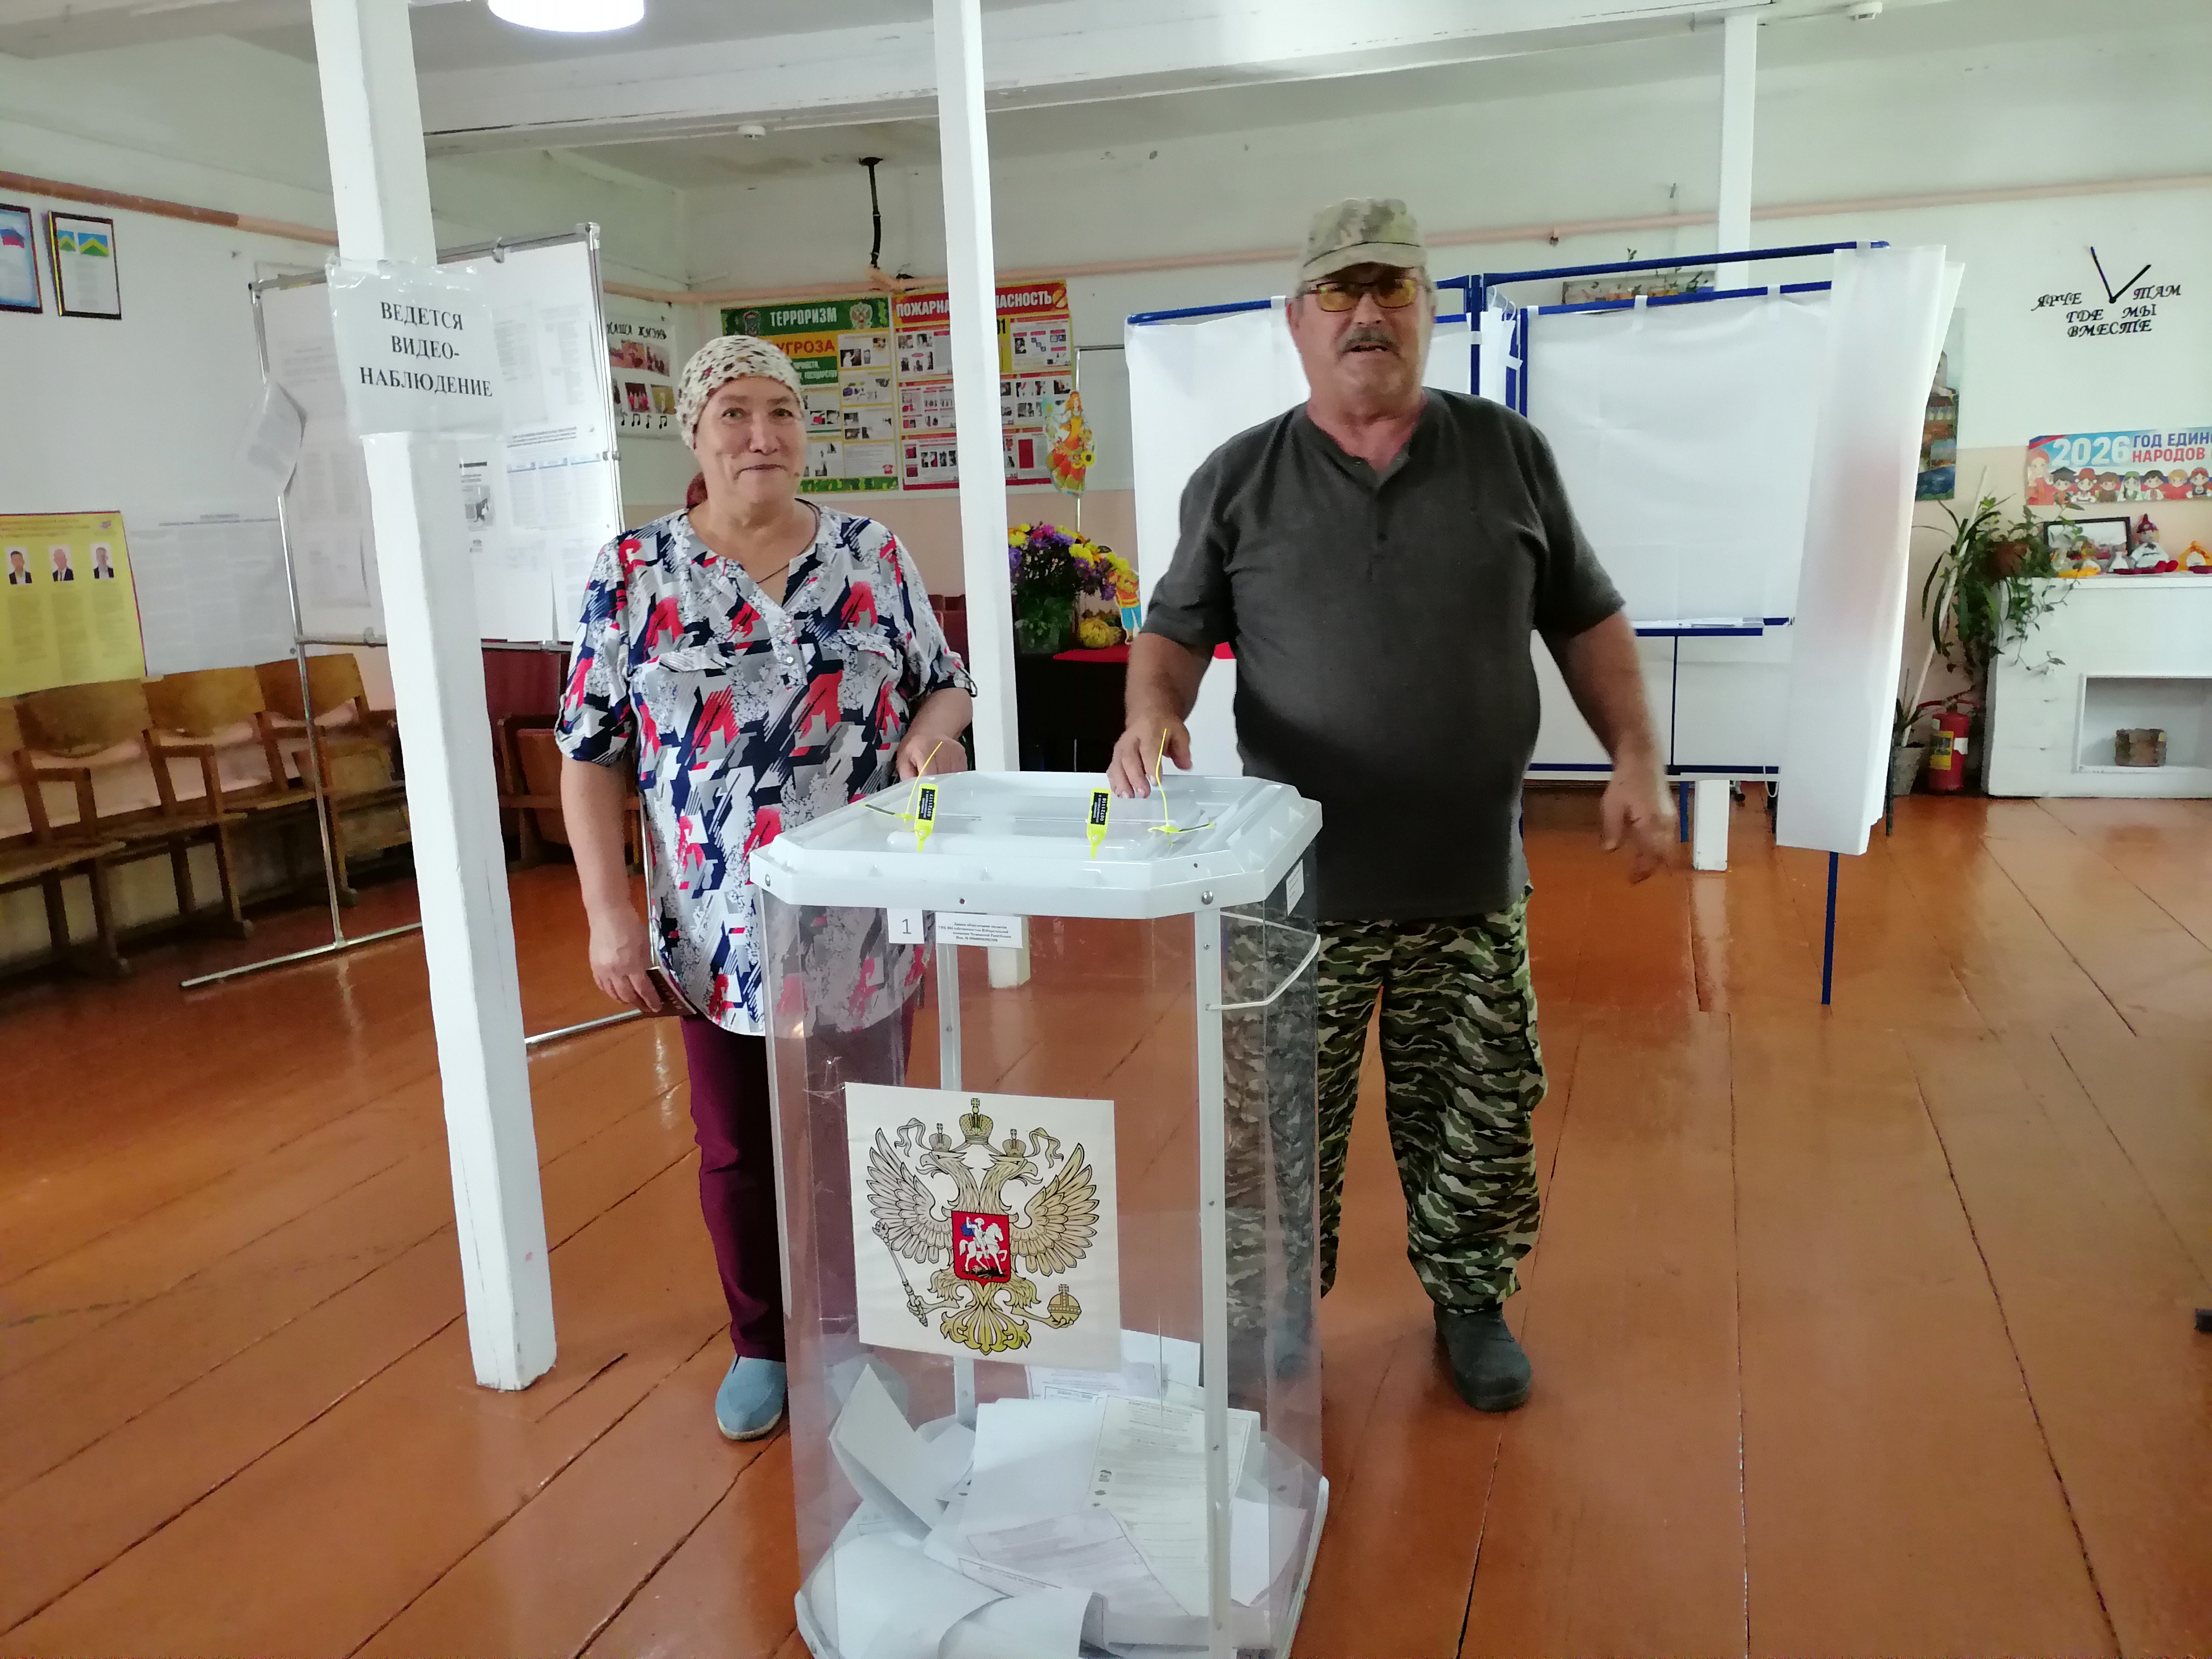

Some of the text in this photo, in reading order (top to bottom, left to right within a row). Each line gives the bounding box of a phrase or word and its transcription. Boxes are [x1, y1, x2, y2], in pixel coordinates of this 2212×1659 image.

[2031, 284, 2182, 312] ЯРЧЕ ТАМ
[381, 301, 463, 331] ВЕДЕТСЯ
[770, 307, 837, 327] ТЕРРОРИЗМ
[896, 299, 949, 317] ПОЖАРНА
[2066, 304, 2157, 323] ГДЕ МЫ
[2067, 319, 2152, 338] ВМЕСТЕ
[392, 335, 460, 366] ВИДЕО-
[776, 339, 835, 355] УГРОЗА
[359, 366, 494, 397] НАБЛЮДЕНИЕ
[2134, 431, 2212, 448] ГОД ЕДИН
[2052, 435, 2130, 467] 2026
[2133, 447, 2205, 463] НАРОДОВ
[902, 919, 912, 934] 1
